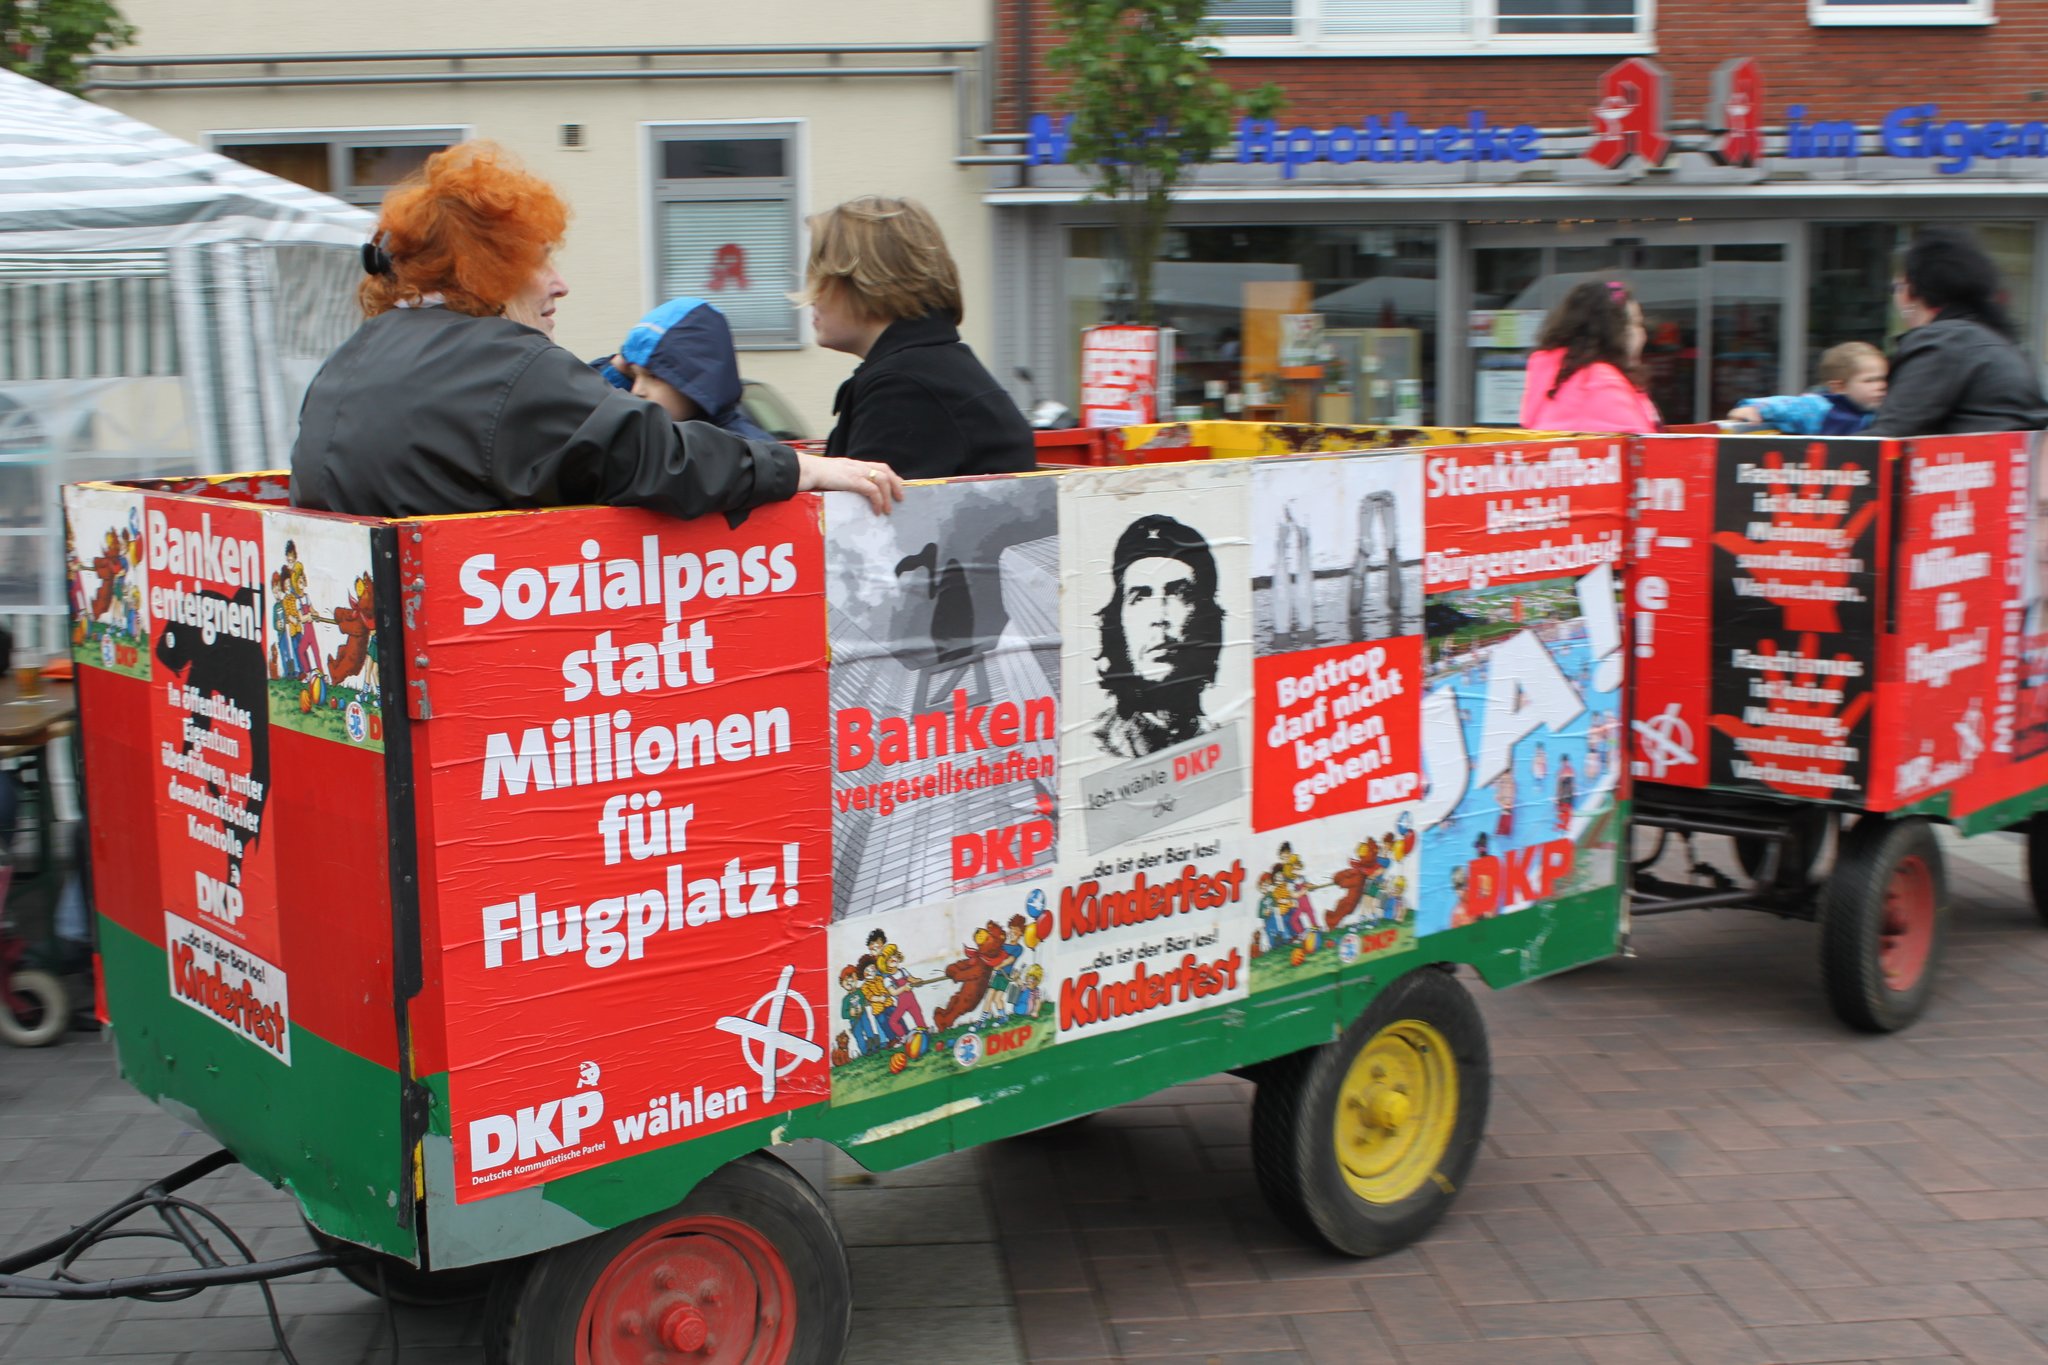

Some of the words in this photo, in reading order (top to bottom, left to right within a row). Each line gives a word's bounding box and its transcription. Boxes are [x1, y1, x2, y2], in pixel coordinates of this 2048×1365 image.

[1238, 110, 1540, 178] Apotheke
[1786, 104, 1857, 158] im
[148, 510, 261, 592] Banken
[459, 534, 797, 626] Sozialpass
[151, 580, 262, 646] enteignen!
[562, 618, 715, 702] statt
[1276, 646, 1386, 708] Bottrop
[182, 684, 252, 730] öffentliches
[182, 717, 240, 759] Eigentum
[836, 688, 1055, 773] Banken
[1267, 696, 1328, 748] darf
[1332, 668, 1404, 719] nicht
[161, 741, 230, 794] überführen,
[231, 772, 264, 801] unter
[481, 706, 791, 800] Millionen
[1118, 770, 1168, 801] wähle
[1172, 743, 1221, 782] DKP
[1294, 715, 1385, 769] baden
[168, 775, 260, 833] demokratischer
[836, 750, 1054, 816] vergesellschaften
[1293, 735, 1392, 812] gehen!
[1367, 772, 1418, 803] DKP
[187, 813, 244, 859] Kontrolle
[598, 790, 694, 866] für
[951, 819, 1054, 881] DKP
[1116, 858, 1134, 875] ist
[1136, 852, 1161, 871] der
[1165, 846, 1191, 864] Bär
[1194, 839, 1221, 858] los!
[195, 870, 244, 926] DKP
[482, 842, 800, 969] Flugplatz!
[1060, 858, 1245, 941] Kinderfest
[1466, 838, 1575, 917] DKP
[214, 941, 230, 965] der
[230, 949, 248, 973] Bär
[1116, 948, 1134, 965] ist
[1136, 942, 1161, 961] der
[1165, 935, 1191, 954] Bär
[1194, 928, 1220, 947] los!
[1361, 929, 1398, 954] DKP
[172, 938, 285, 1054] Kinderfest
[1060, 947, 1241, 1031] Kinderfest
[986, 1025, 1032, 1056] DKP
[469, 1090, 604, 1172] DKP
[612, 1084, 748, 1145] wählen
[472, 1167, 513, 1186] Deutsche
[514, 1150, 581, 1175] Kommunistische
[582, 1141, 606, 1155] Partei
